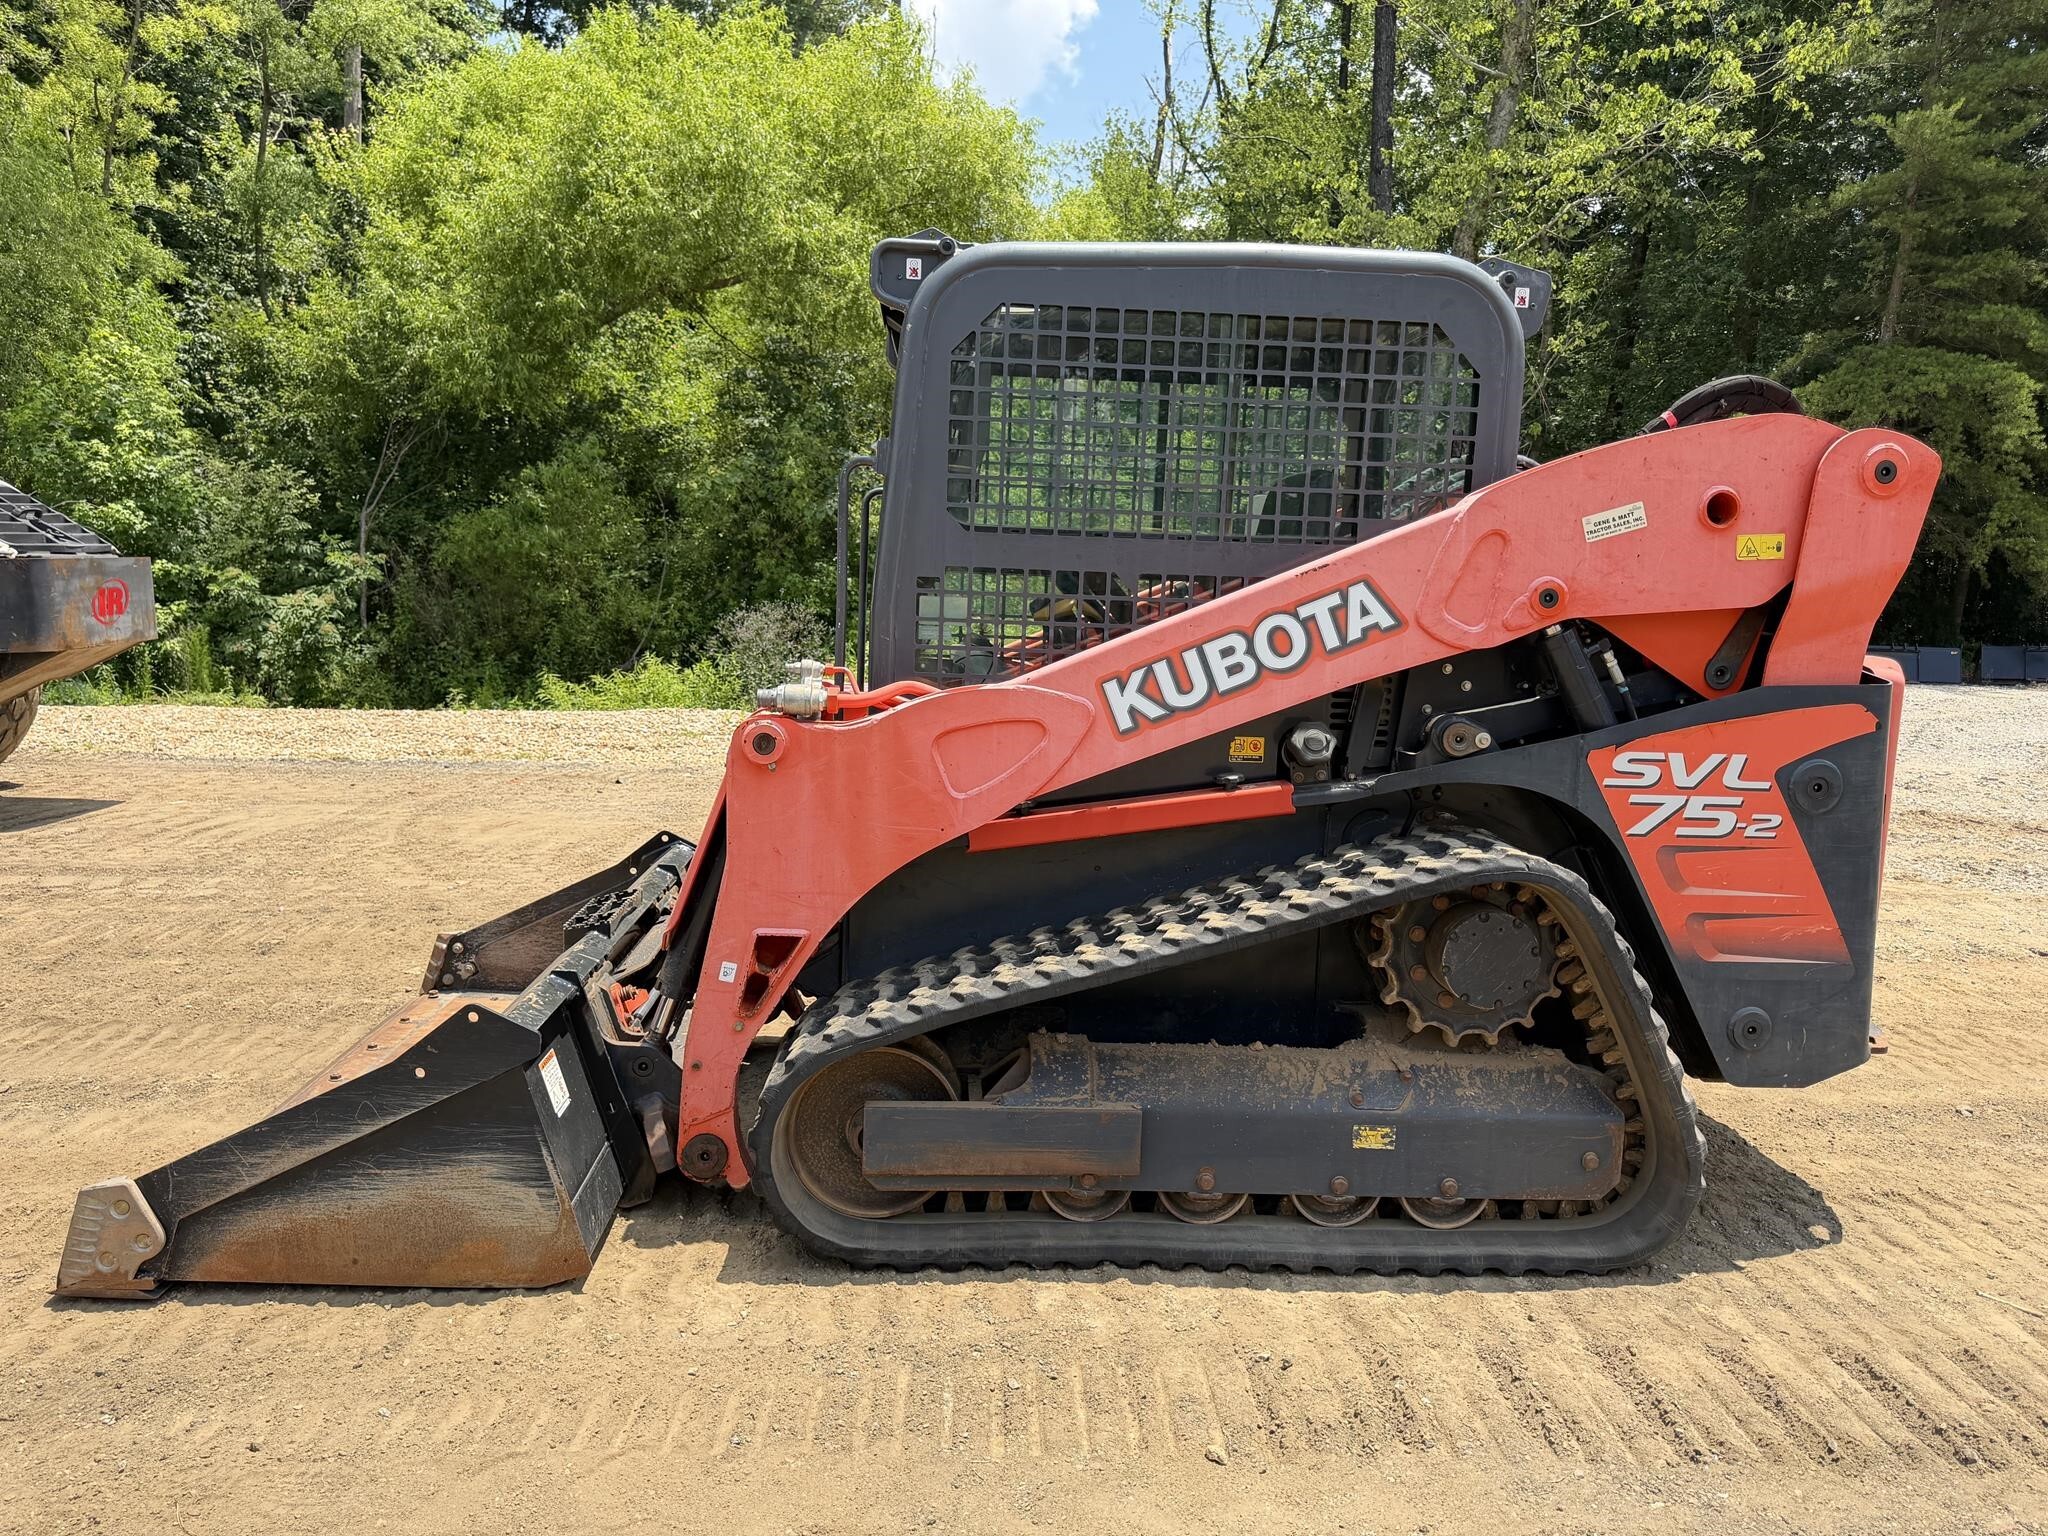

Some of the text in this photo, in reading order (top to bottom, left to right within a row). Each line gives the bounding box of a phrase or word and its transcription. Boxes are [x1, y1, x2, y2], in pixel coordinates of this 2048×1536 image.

[1586, 525, 1612, 536] TRACTOR
[1593, 518, 1611, 528] GENE
[1617, 511, 1635, 521] MATT
[97, 586, 125, 618] IR
[1102, 580, 1401, 733] KUBOTA
[1602, 751, 1772, 791] SVL
[1625, 794, 1784, 839] 75-2
